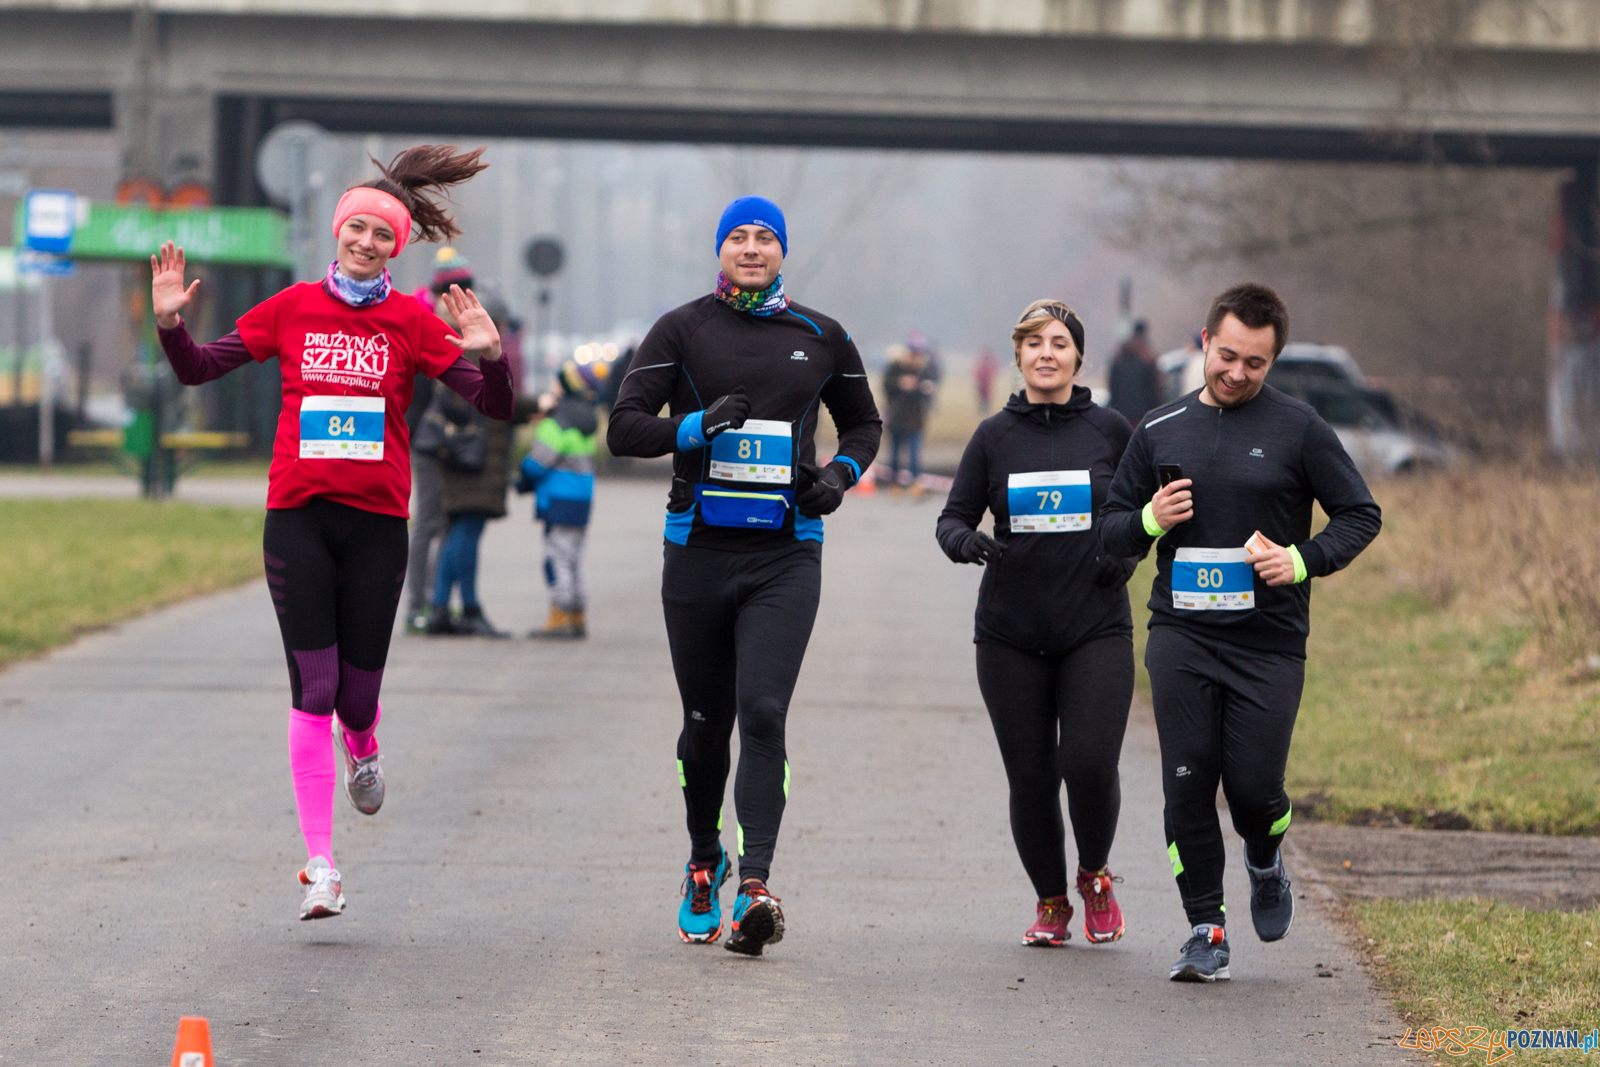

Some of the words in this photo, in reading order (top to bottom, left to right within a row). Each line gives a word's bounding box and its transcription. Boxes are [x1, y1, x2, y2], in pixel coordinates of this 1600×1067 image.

[304, 330, 375, 353] DRUŻYNA
[301, 348, 389, 376] SZPIKU
[301, 372, 381, 391] www.darszpiku.pl
[328, 415, 356, 436] 84
[737, 438, 762, 460] 81
[1036, 489, 1063, 510] 79
[1196, 567, 1224, 588] 80
